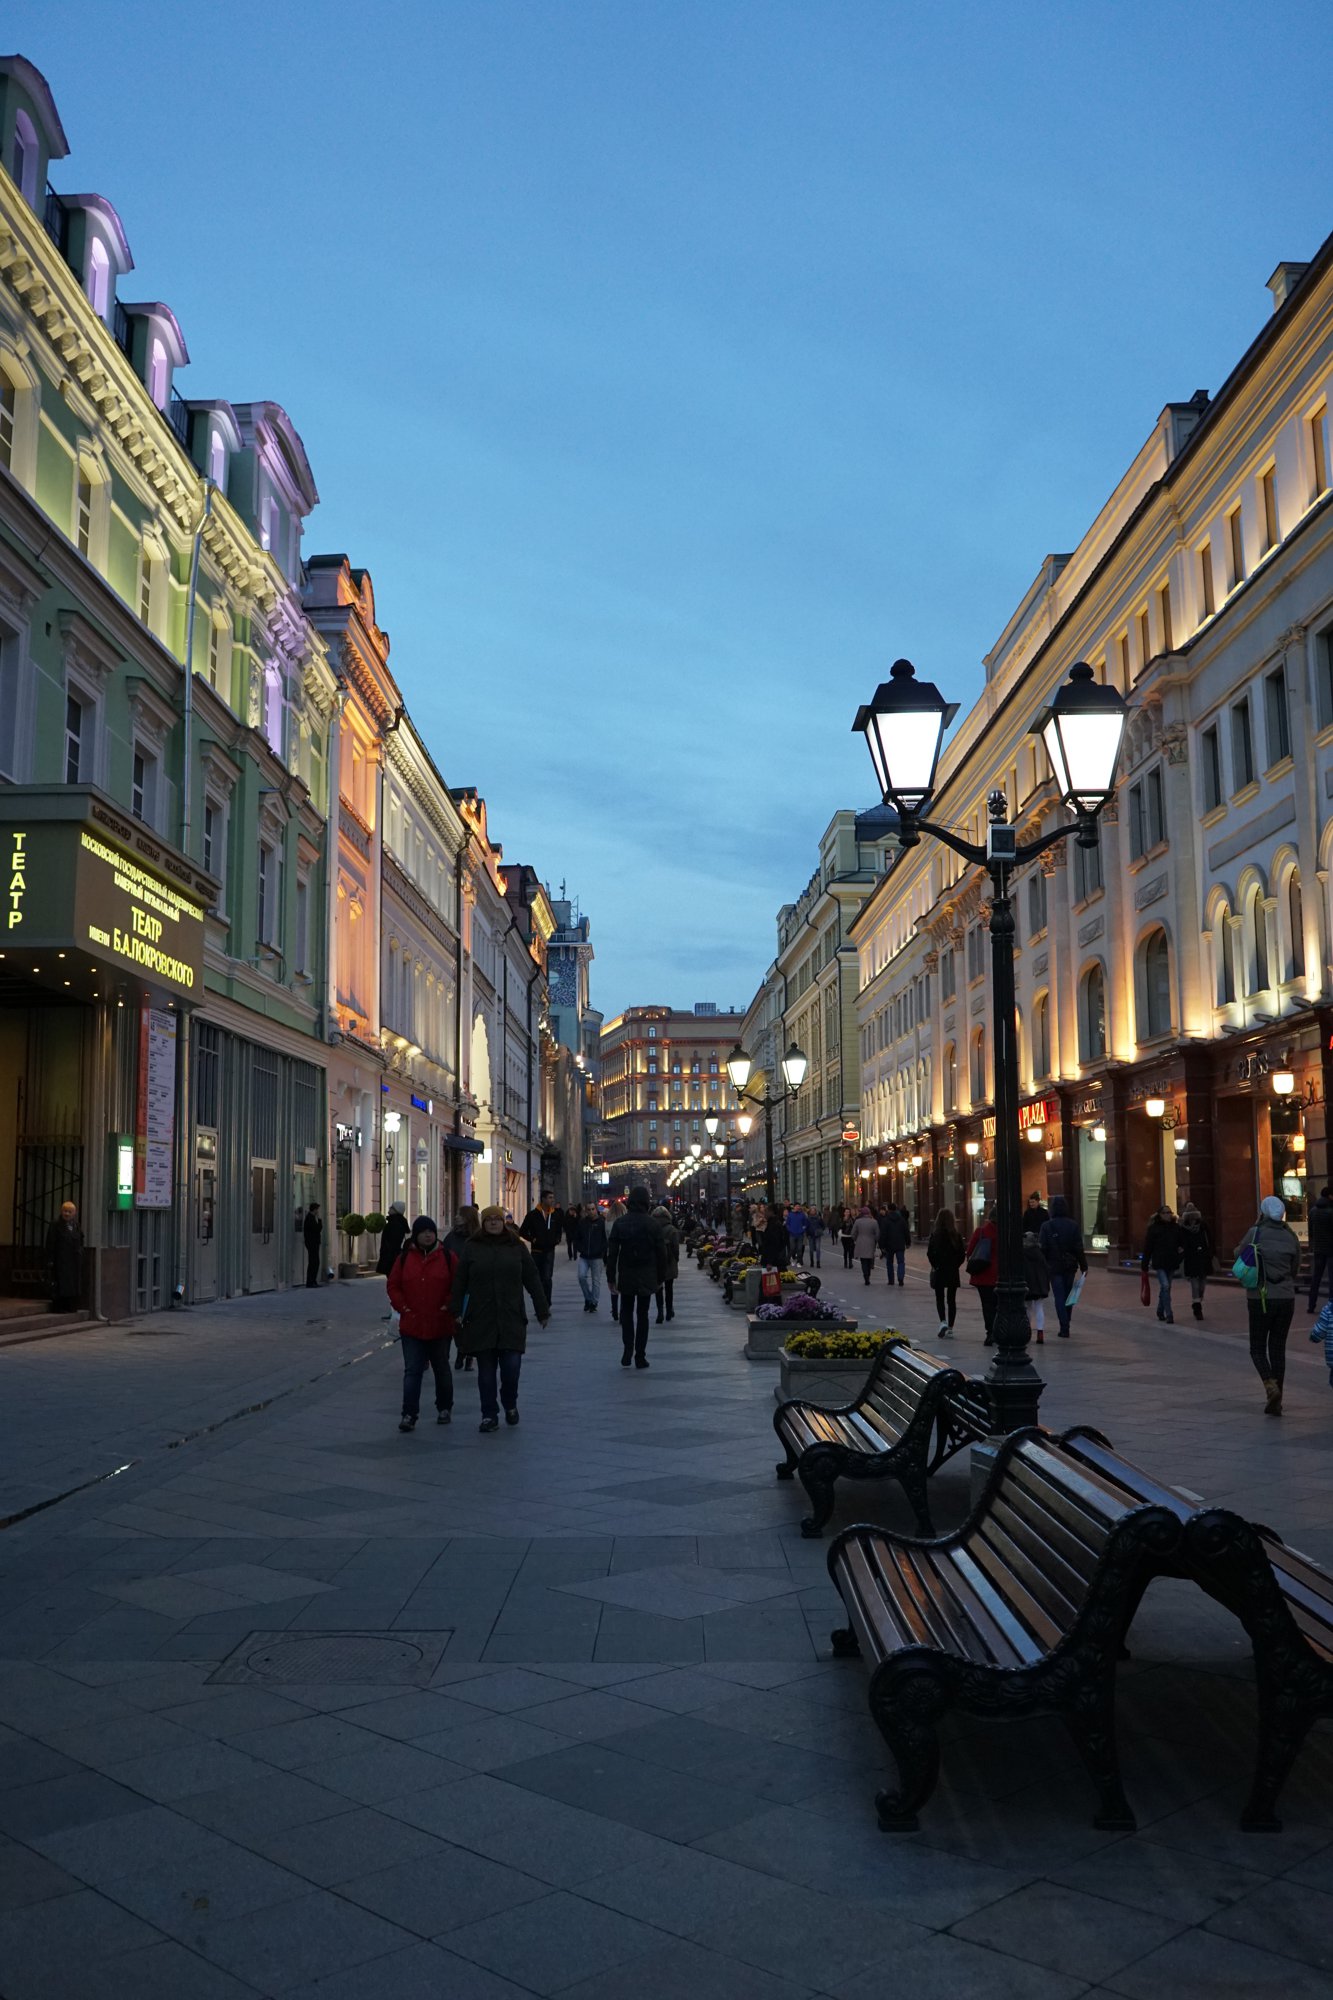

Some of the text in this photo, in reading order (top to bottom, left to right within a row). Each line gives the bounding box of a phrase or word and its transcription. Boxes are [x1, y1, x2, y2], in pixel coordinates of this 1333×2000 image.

[9, 832, 27, 929] ТЕАТР
[81, 832, 120, 869] МОСКОВСКИЙ
[119, 857, 168, 901] ГОСУДАРСТВЕННЫЙ
[167, 889, 204, 923] АКАДЕМИЧЕСКИЙ
[114, 870, 144, 900] КАМЕРНЫЙ
[143, 889, 180, 923] МУЗЫКАЛЬНЫЙ
[89, 924, 110, 948] ИМЕНИ
[131, 905, 162, 944] ТЕАТР
[1022, 1100, 1046, 1129] PLAZA
